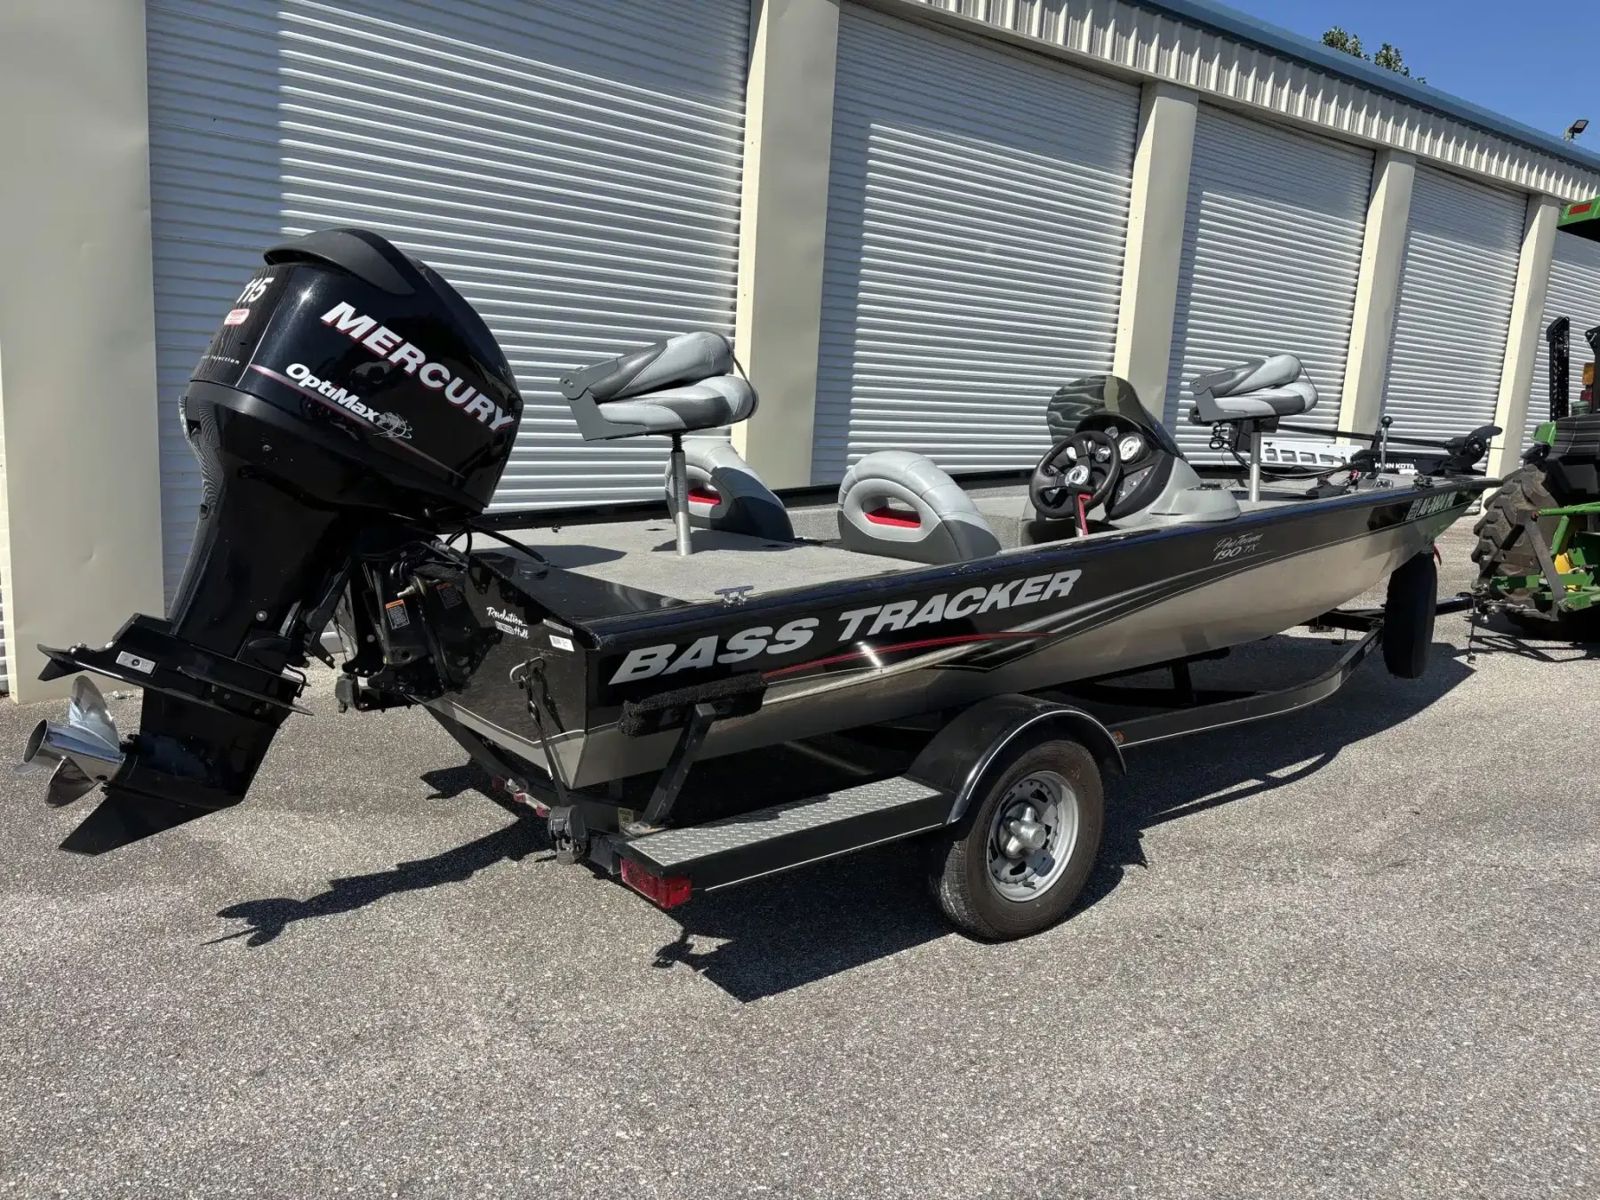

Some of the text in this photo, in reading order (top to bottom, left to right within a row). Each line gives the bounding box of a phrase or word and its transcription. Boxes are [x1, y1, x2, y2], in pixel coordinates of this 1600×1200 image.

[236, 277, 275, 304] 115
[319, 300, 514, 432] MERCURY
[285, 362, 381, 423] OptiMax
[1395, 462, 1415, 470] KOTA
[1213, 546, 1242, 561] 190
[608, 568, 1083, 686] BASS TRACKER
